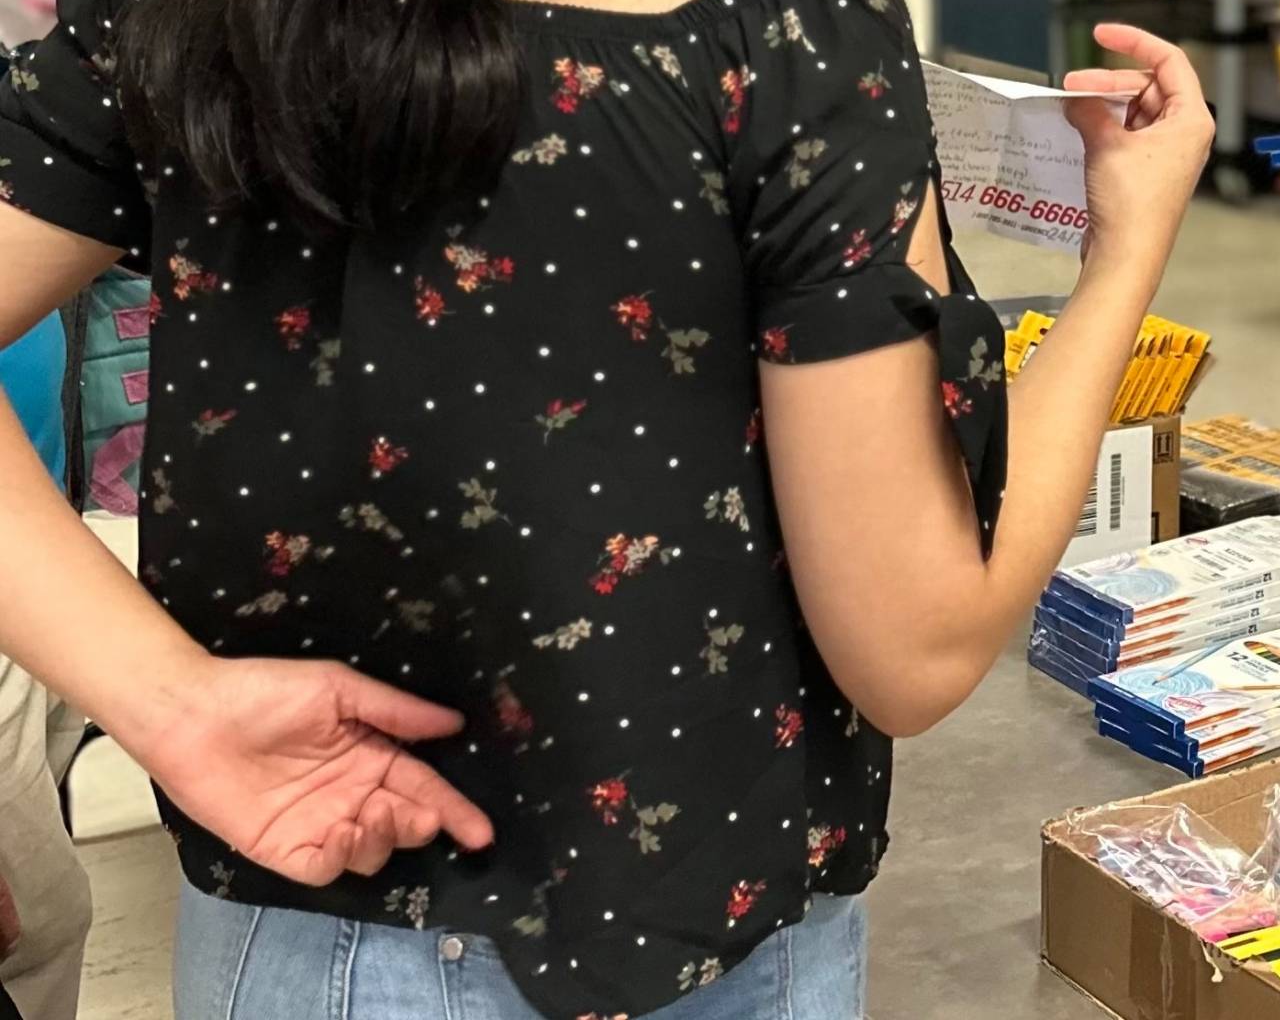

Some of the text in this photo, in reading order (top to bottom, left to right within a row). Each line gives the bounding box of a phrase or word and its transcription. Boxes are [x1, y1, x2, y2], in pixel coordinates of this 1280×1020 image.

[941, 180, 976, 203] 514
[979, 186, 1089, 230] 666-6666
[1225, 651, 1244, 662] 12
